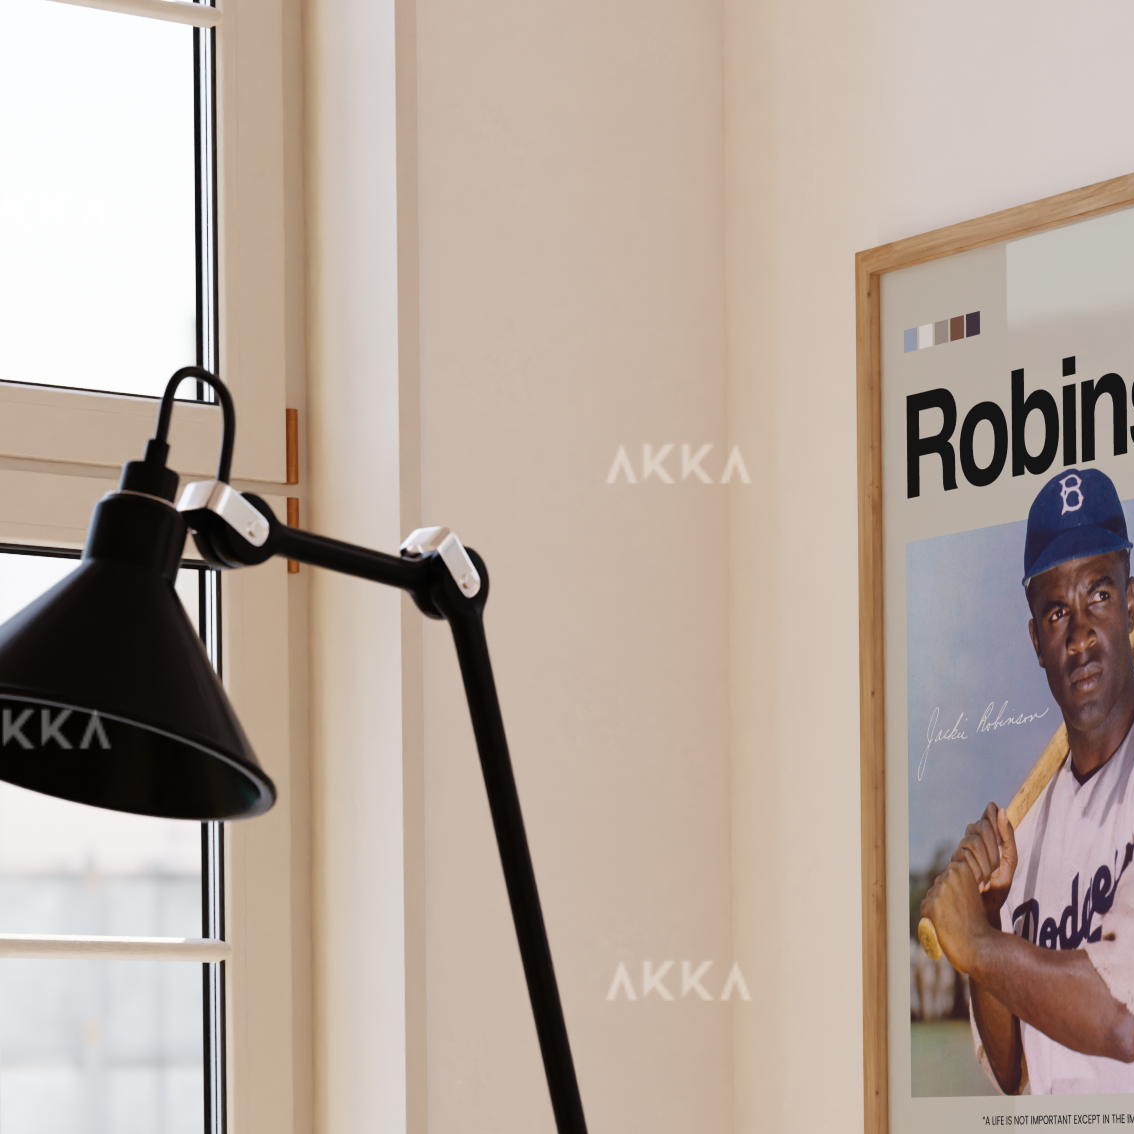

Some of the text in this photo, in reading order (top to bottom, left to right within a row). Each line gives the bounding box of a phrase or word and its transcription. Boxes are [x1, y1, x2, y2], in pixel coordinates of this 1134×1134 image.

[1059, 474, 1083, 514] B
[983, 1116, 991, 1126] "A
[992, 1116, 1005, 1126] LIFE
[1006, 1116, 1013, 1126] IS
[1015, 1115, 1029, 1126] NOT
[1031, 1114, 1072, 1126] IMPORTANT
[1074, 1114, 1101, 1125] EXCEPT
[1103, 1114, 1110, 1124] IN
[1112, 1114, 1126, 1124] THE
